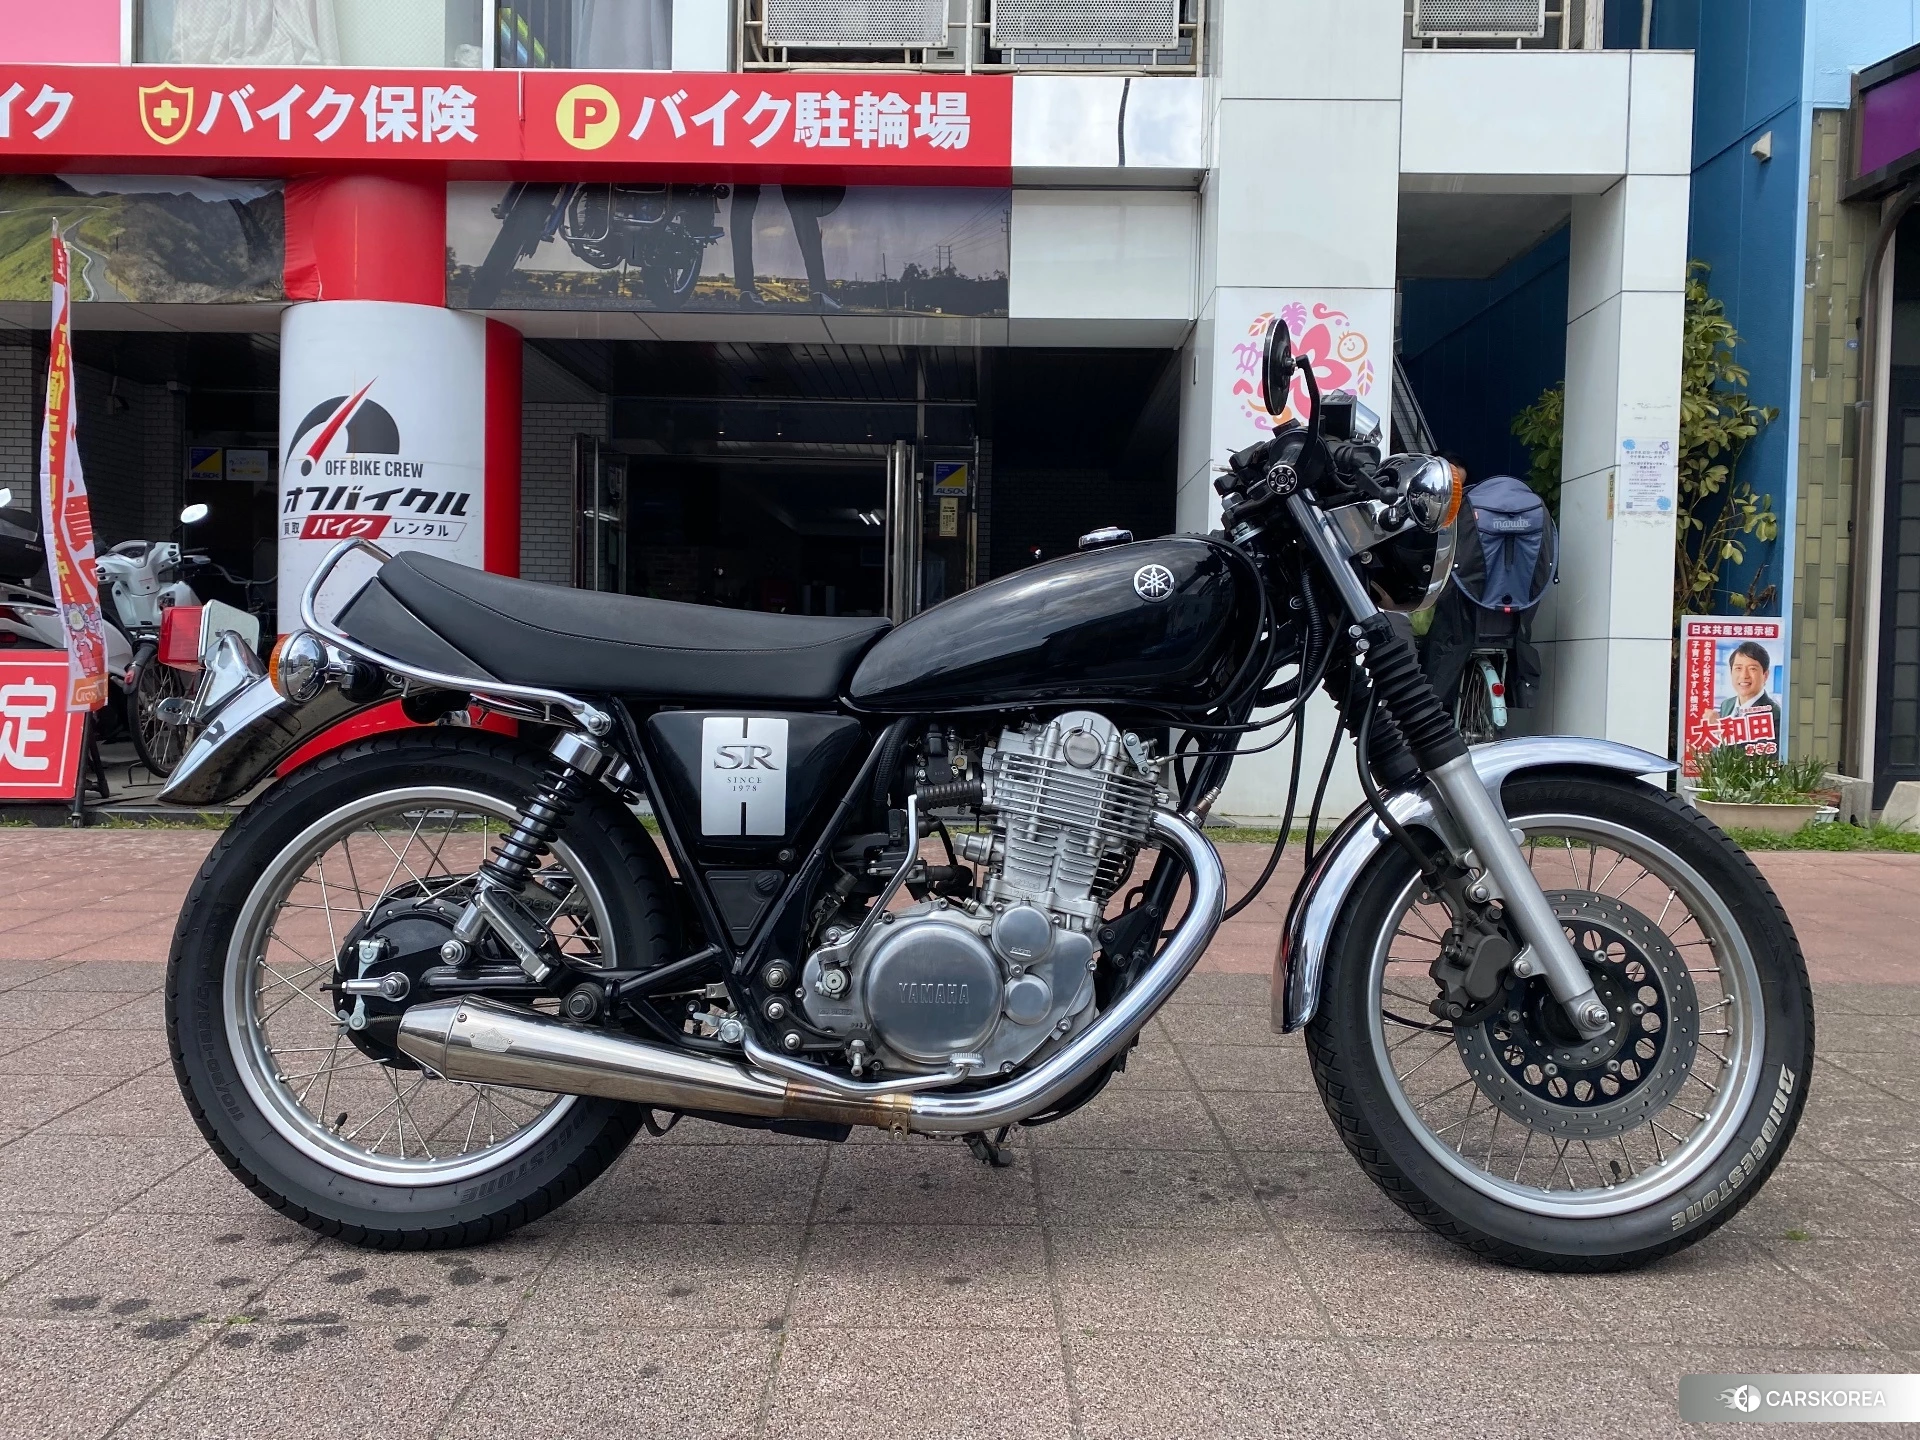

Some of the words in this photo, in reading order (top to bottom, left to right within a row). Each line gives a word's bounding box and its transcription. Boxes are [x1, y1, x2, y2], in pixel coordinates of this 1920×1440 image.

[197, 83, 478, 144] バイク保険
[573, 98, 608, 139] P
[628, 88, 971, 150] バイク駐輪場
[325, 460, 346, 476] OFF
[350, 460, 380, 476] BIKE
[385, 461, 424, 478] CREW
[283, 485, 471, 517] オフバイクル
[310, 518, 373, 535] バイク
[394, 522, 449, 537] レンタル
[1691, 624, 1775, 637] 日本共産党掲示板
[0, 676, 57, 771] 定
[1691, 713, 1775, 750] 大和田
[713, 744, 780, 771] SR
[727, 776, 762, 784] SINCE
[899, 982, 970, 1004] YAMAHA
[1671, 1063, 1796, 1232] BRIDGESTONE
